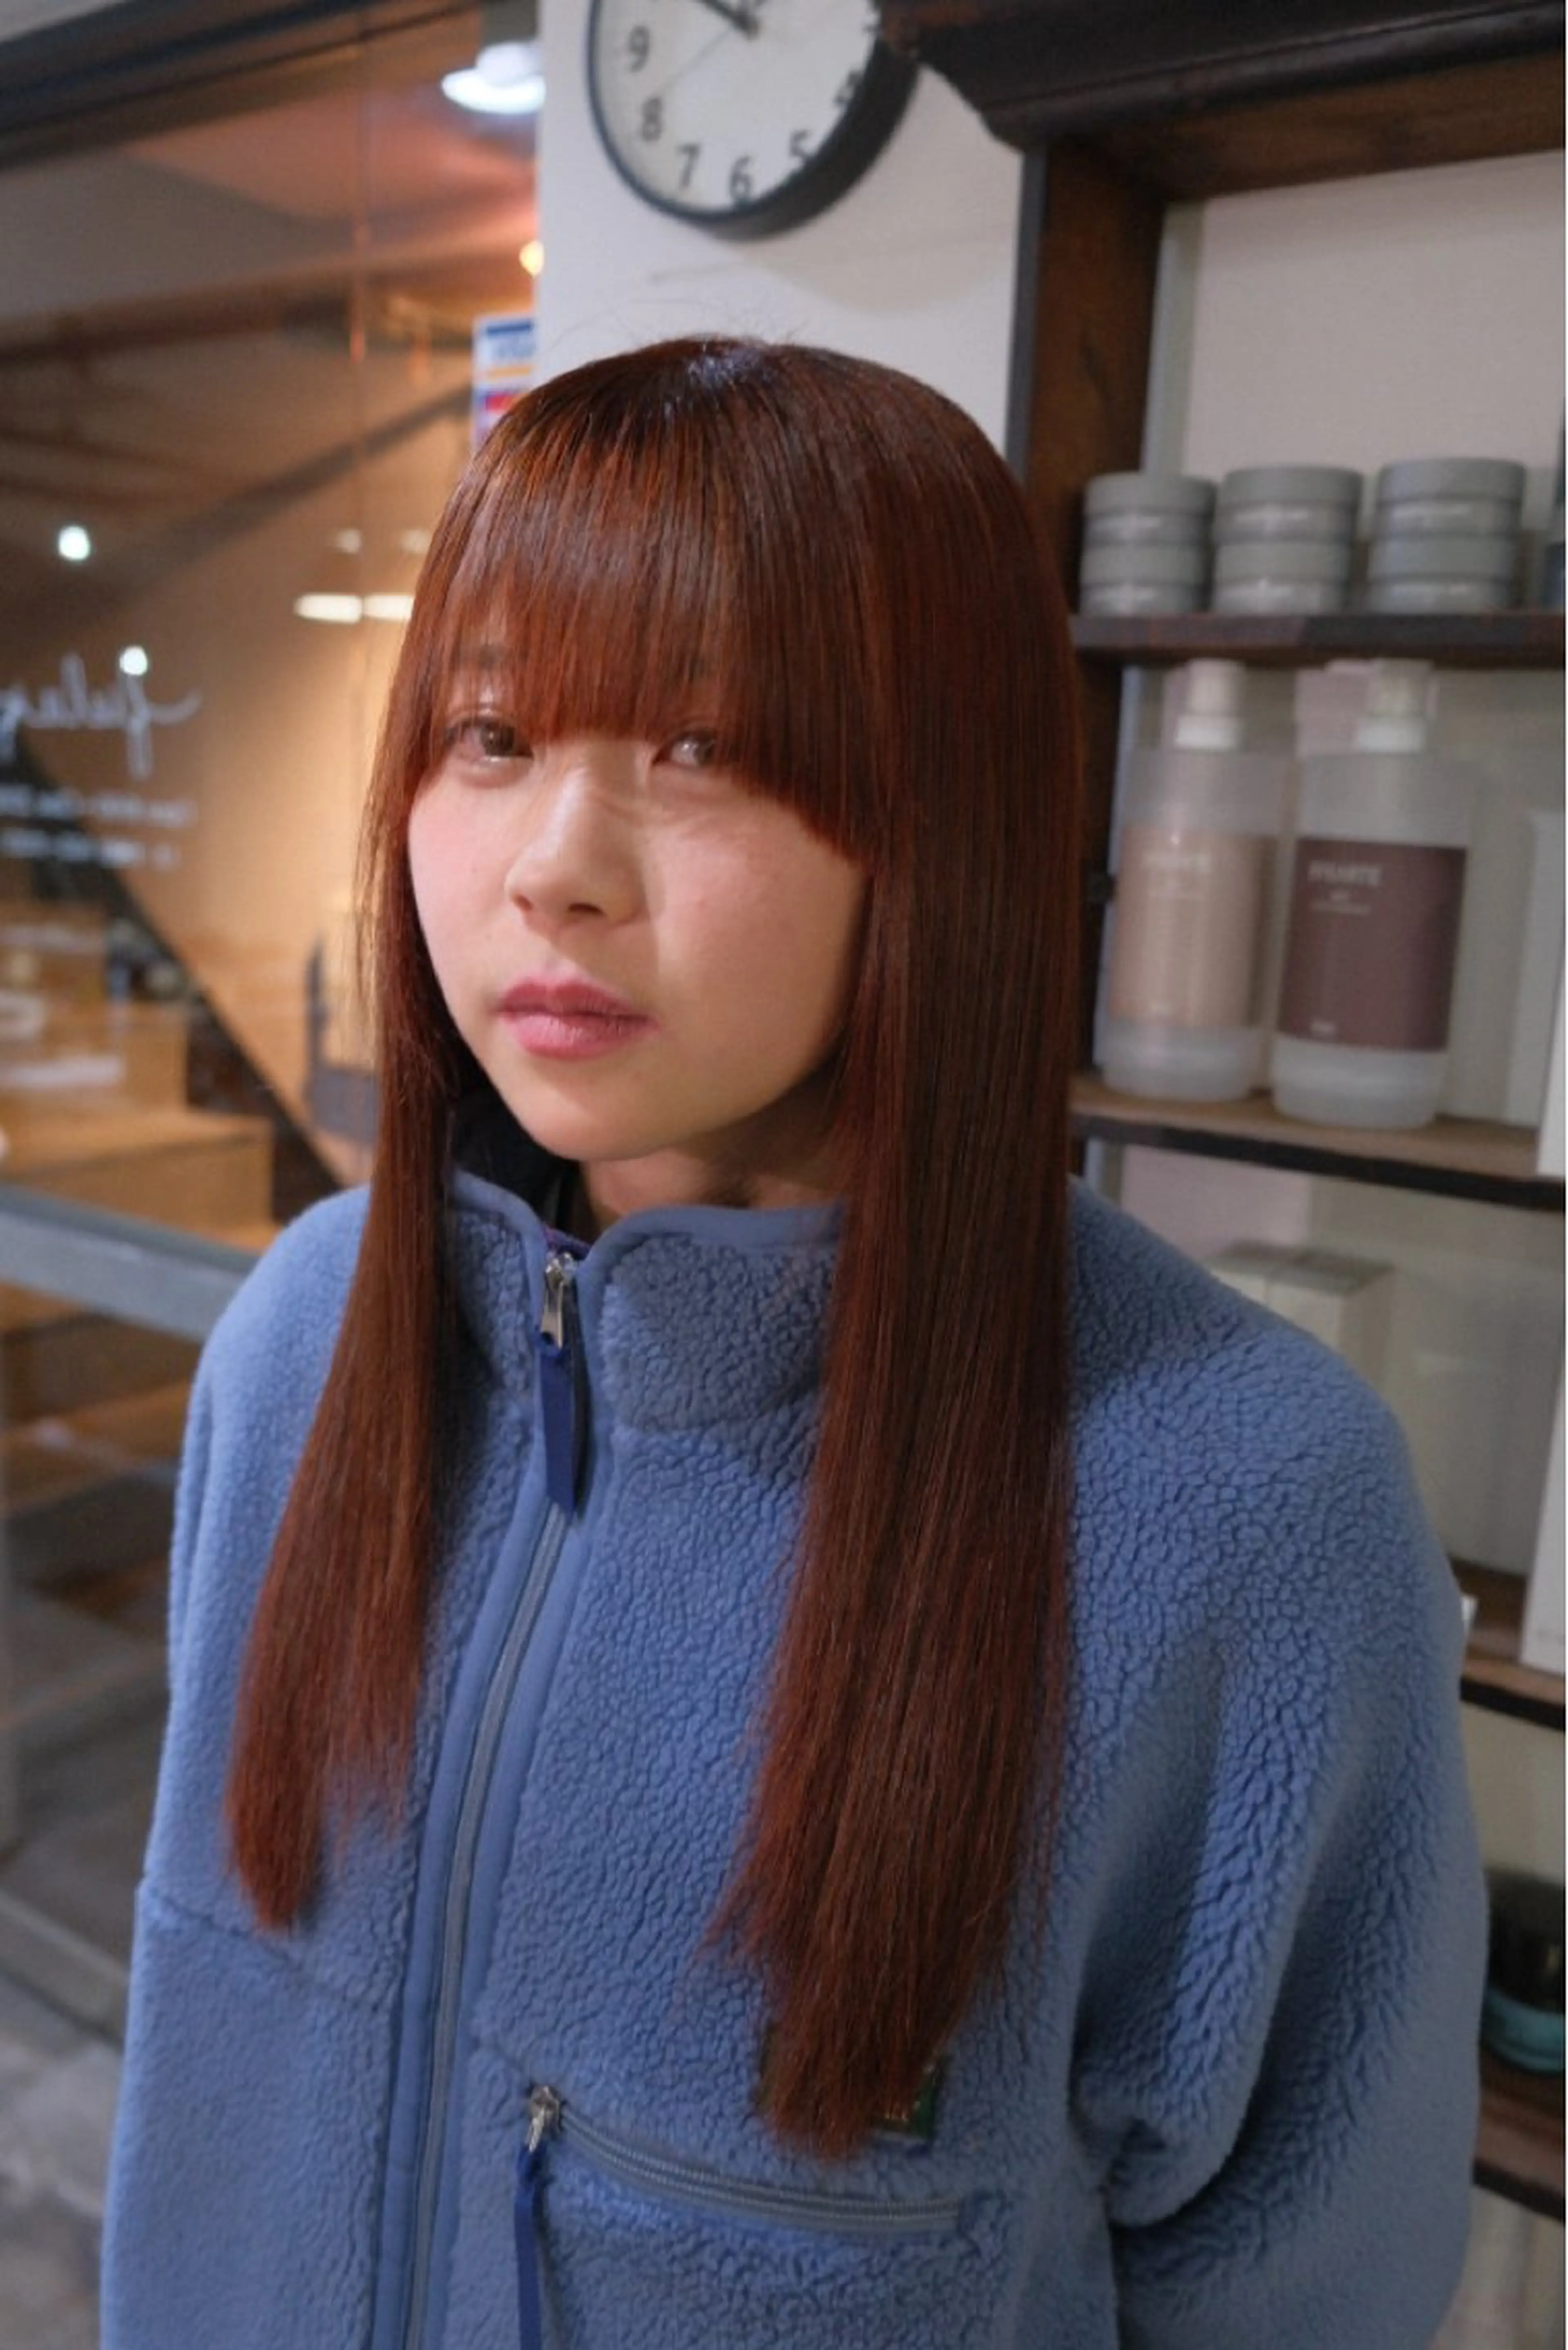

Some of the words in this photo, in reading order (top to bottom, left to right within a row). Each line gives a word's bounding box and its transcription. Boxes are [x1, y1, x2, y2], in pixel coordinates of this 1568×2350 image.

[628, 25, 650, 73] 9
[641, 96, 663, 142] 8
[676, 143, 701, 189] 7
[729, 155, 753, 203] 6
